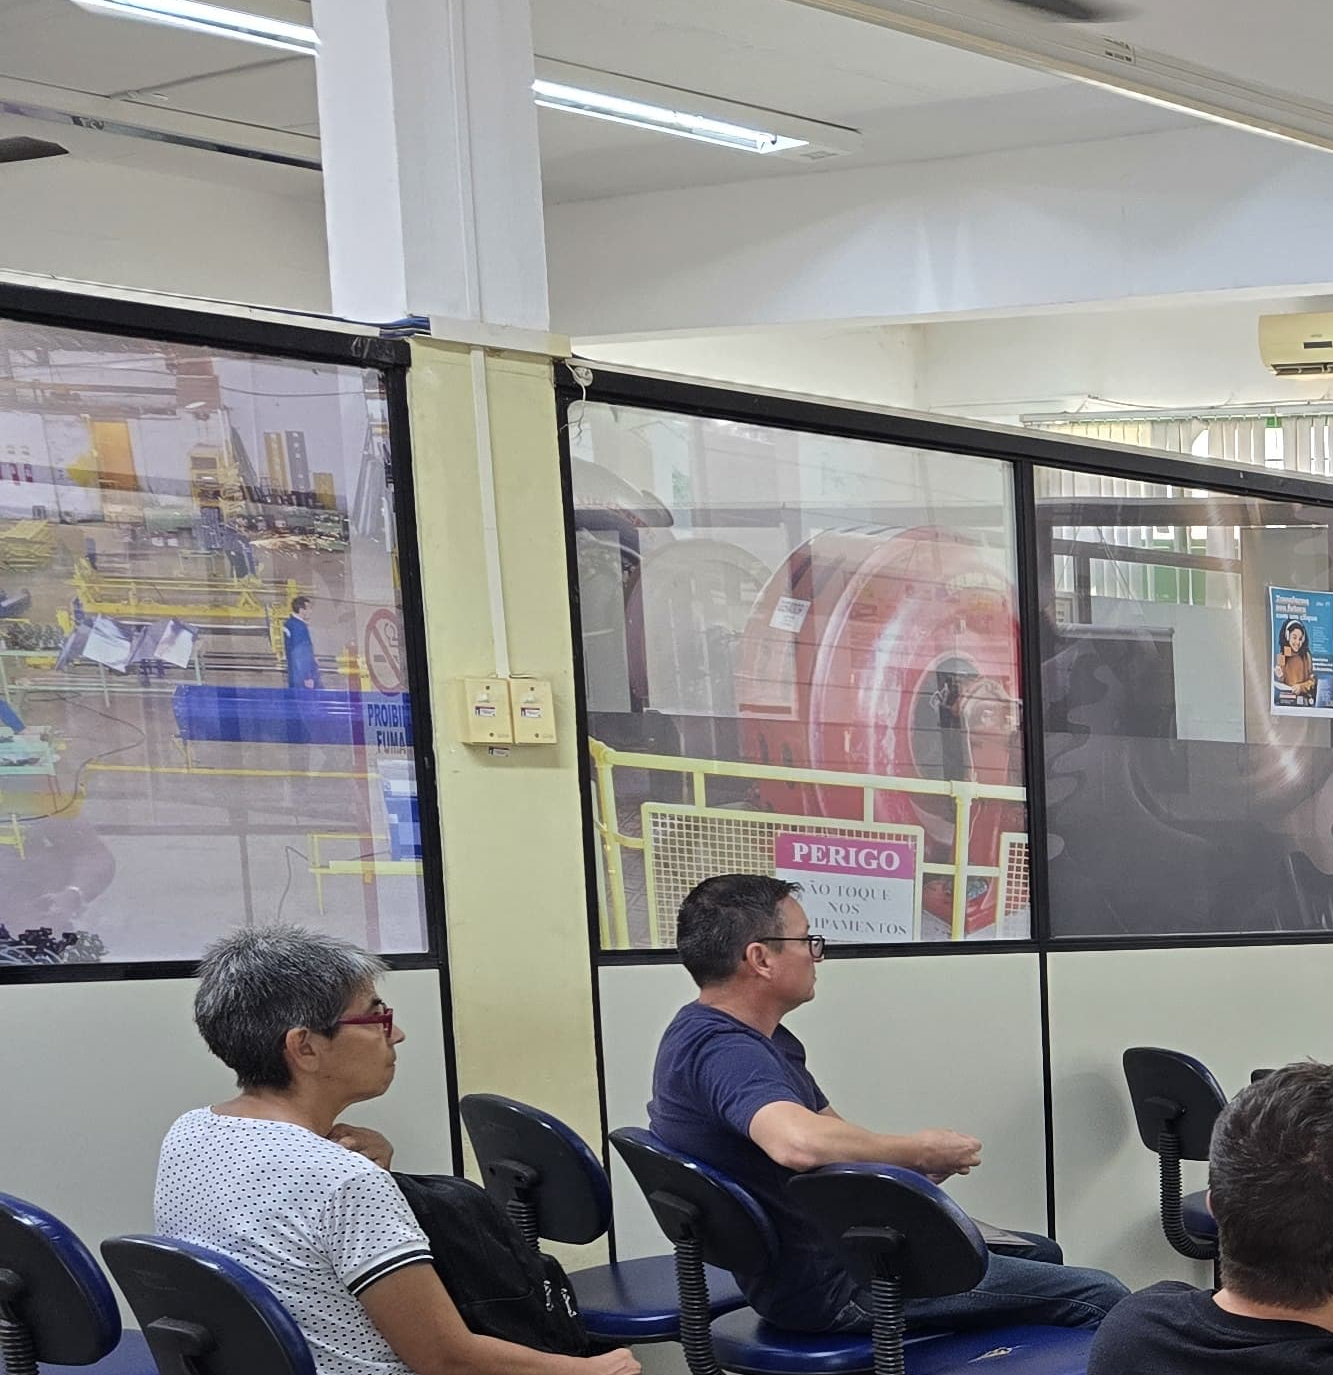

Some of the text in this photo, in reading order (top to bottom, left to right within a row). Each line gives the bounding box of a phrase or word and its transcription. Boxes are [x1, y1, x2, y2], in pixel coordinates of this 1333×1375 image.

[792, 841, 900, 871] PERIGO
[838, 885, 890, 901] TOQUE
[828, 901, 860, 915] NOS
[814, 917, 907, 935] IPAMENTOS
